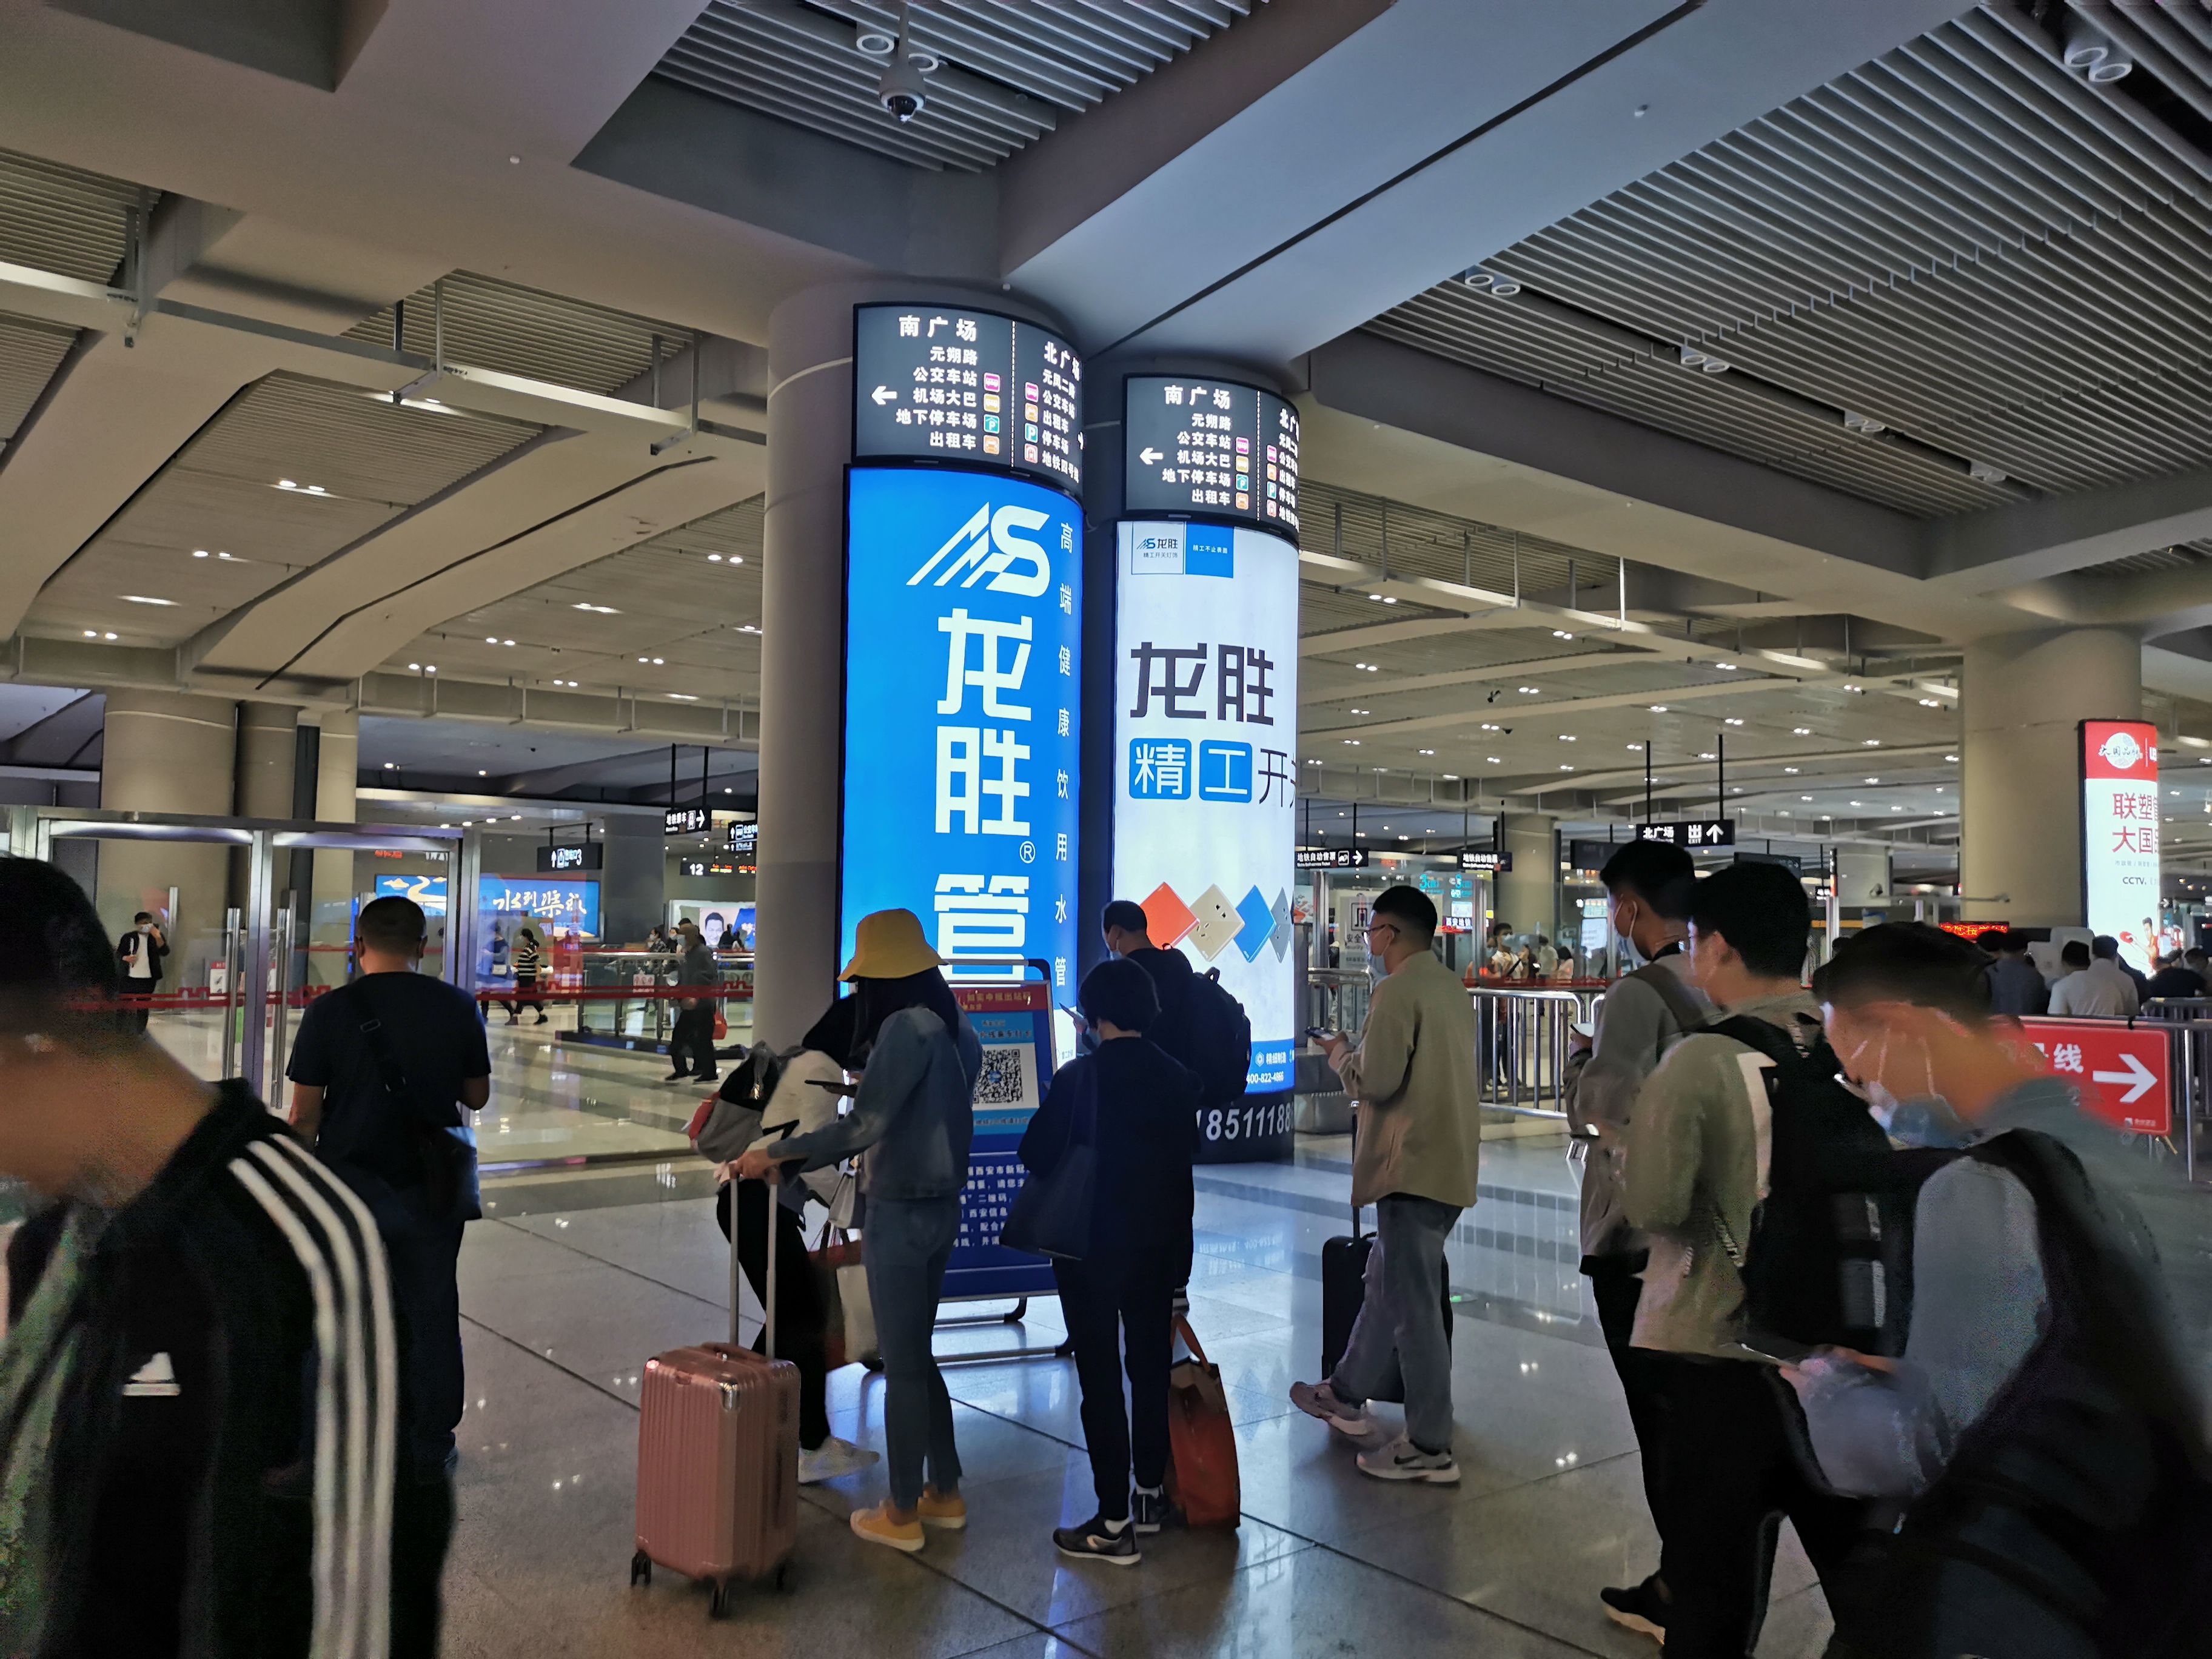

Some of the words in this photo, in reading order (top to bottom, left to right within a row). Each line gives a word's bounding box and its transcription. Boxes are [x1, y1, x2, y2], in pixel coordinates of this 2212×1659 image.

[899, 315, 977, 341] 南广场
[930, 346, 977, 366] 元朔路
[1044, 341, 1080, 381] 北广场
[913, 367, 977, 387] 公交车站
[913, 387, 977, 407] 机场大巴
[1042, 389, 1075, 420] 公交车站
[1164, 385, 1231, 409] 南广场
[896, 408, 977, 429] 地下停车场
[1043, 410, 1069, 434] 出租车
[1191, 413, 1231, 431] 元朔路
[930, 431, 976, 450] 出租车
[1042, 429, 1069, 455] 停车场
[1177, 431, 1231, 449] 公交车站
[1042, 450, 1079, 483] 地铁四号线
[1177, 449, 1231, 468] 机场大巴
[1162, 468, 1231, 488] 地下停车场
[1191, 489, 1231, 506] 出租车
[1158, 538, 1178, 549] 龙胜
[1130, 642, 1273, 726] 龙胜
[1643, 826, 1674, 839] 北广场
[1297, 851, 1336, 862] 地铁自动售票
[689, 863, 703, 876] 12
